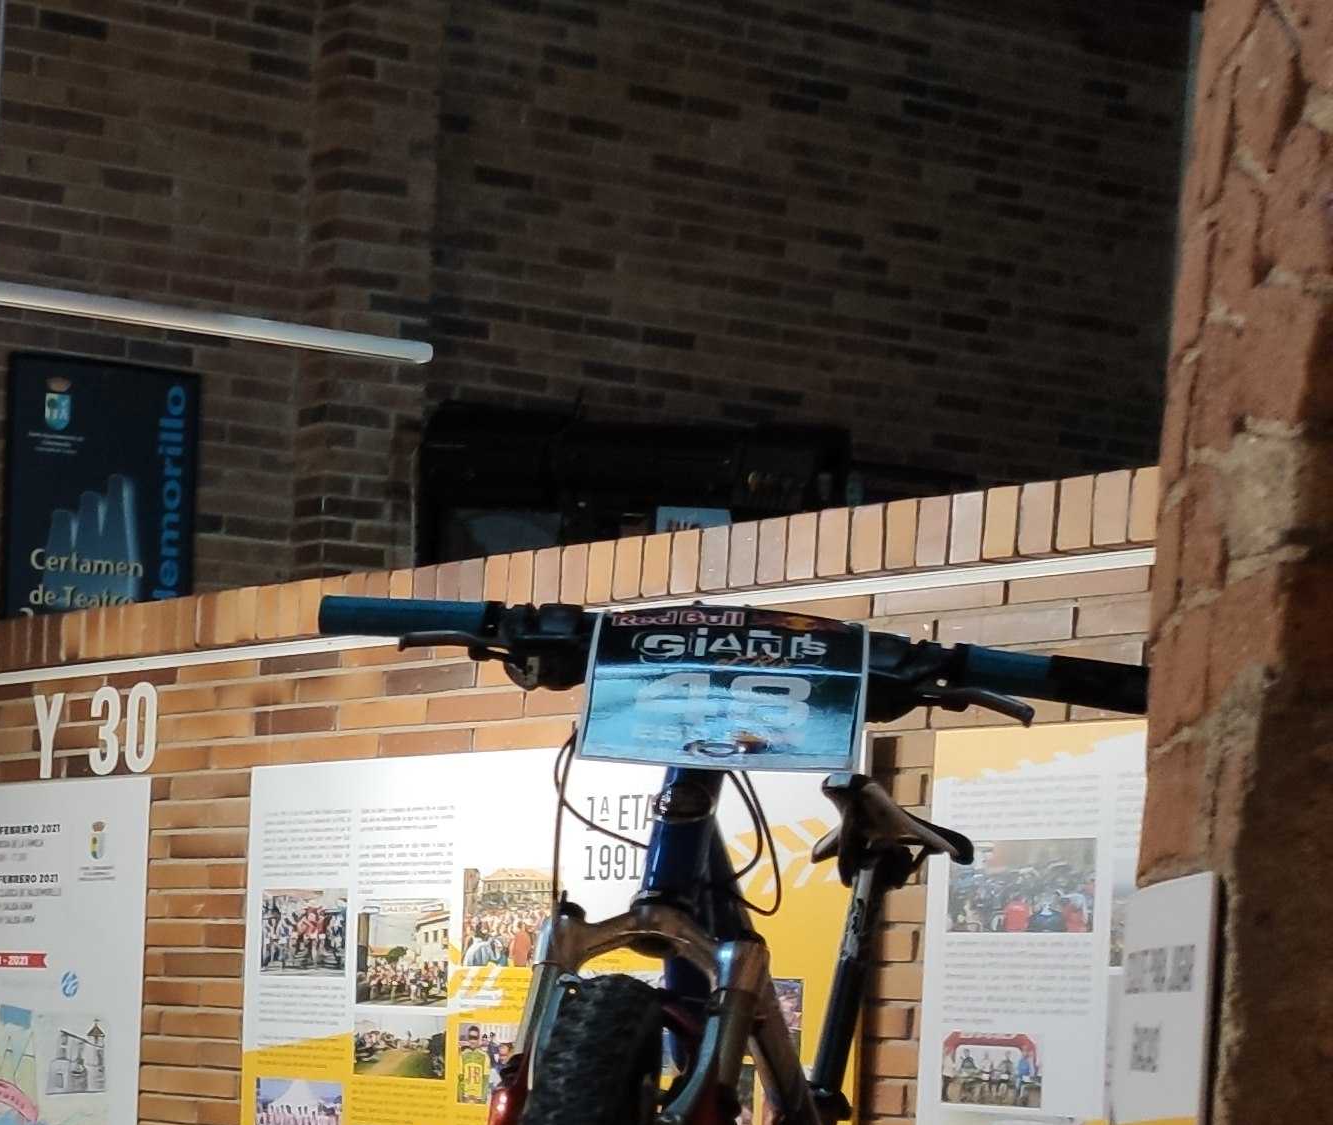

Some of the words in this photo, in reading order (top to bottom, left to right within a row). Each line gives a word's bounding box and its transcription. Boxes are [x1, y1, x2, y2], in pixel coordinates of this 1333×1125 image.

[30, 548, 144, 578] Certamen
[29, 585, 55, 606] de
[612, 610, 677, 627] Red
[682, 610, 745, 627] Bull
[34, 692, 64, 779] Y
[88, 681, 158, 776] 30
[0, 825, 39, 835] FEBRERO
[584, 844, 641, 881] 1991
